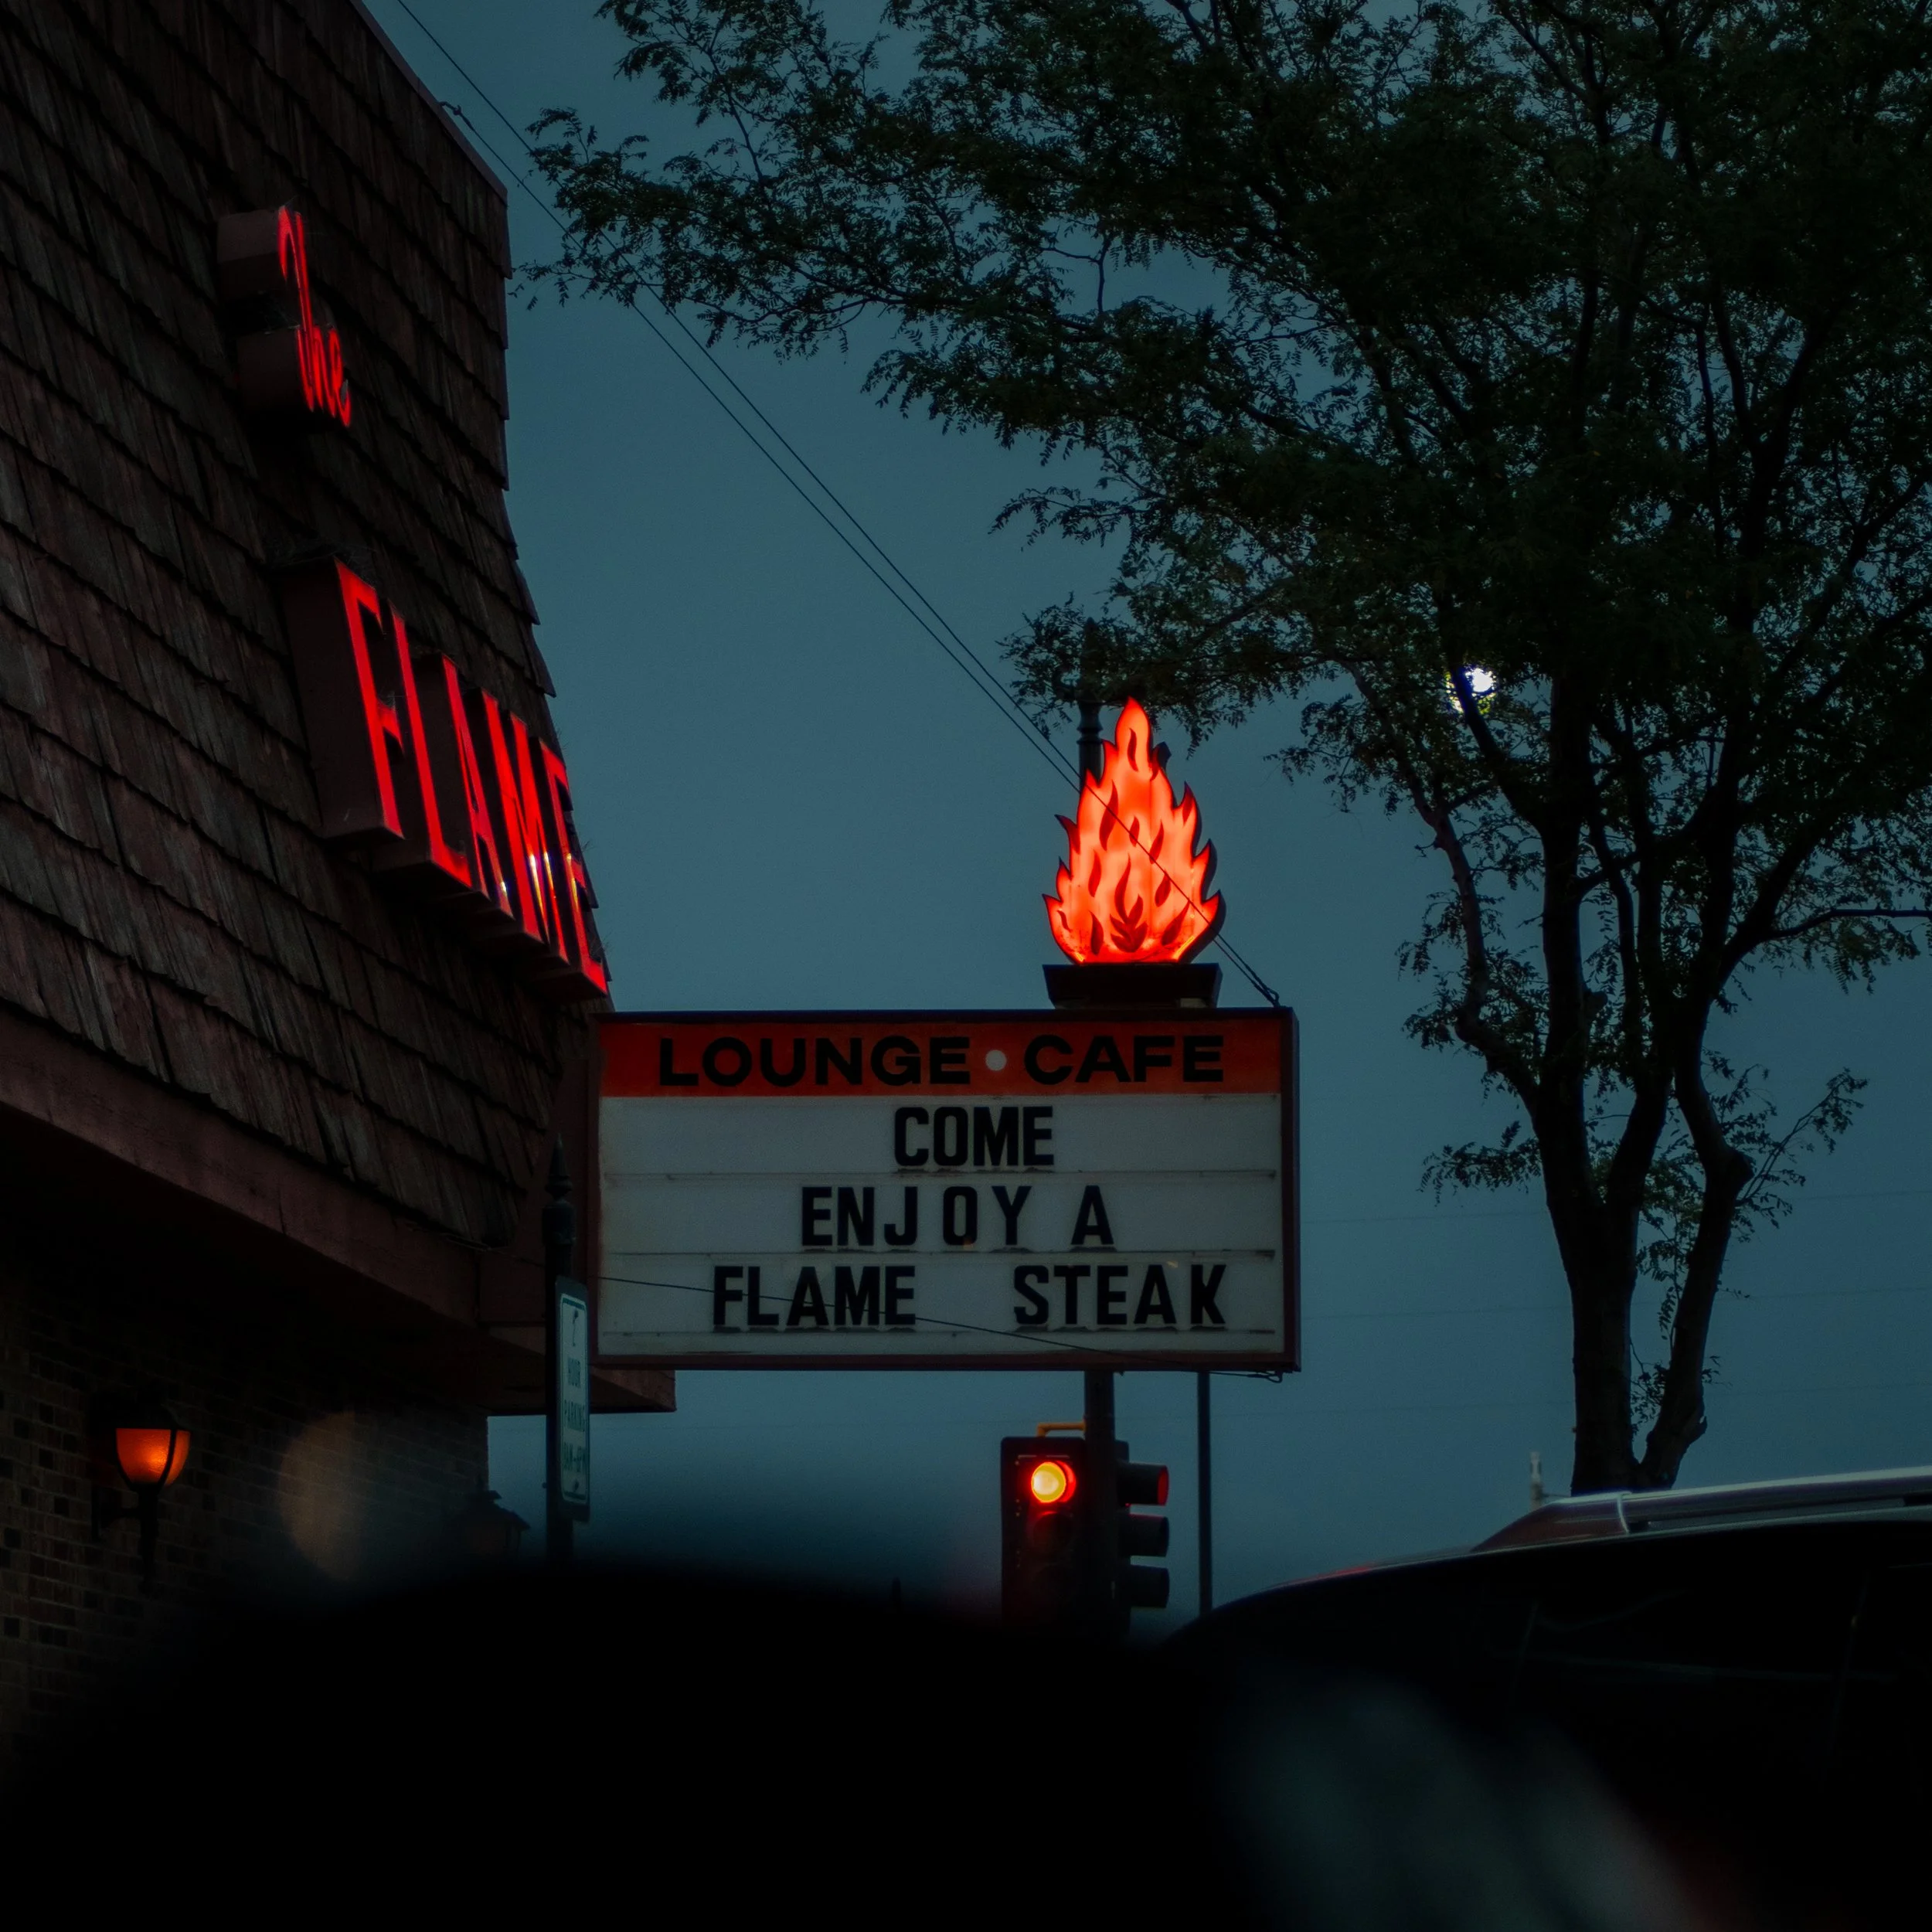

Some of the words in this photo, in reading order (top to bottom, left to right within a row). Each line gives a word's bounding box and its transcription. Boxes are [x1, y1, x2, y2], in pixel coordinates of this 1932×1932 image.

[335, 560, 607, 995] FLAME
[658, 1036, 971, 1087] LOUNGE
[1024, 1034, 1225, 1083] CAFE
[894, 1107, 1055, 1167] COME
[801, 1186, 1032, 1247] ENJOY
[1071, 1185, 1114, 1246] A
[713, 1265, 917, 1327] FLAME
[1013, 1264, 1228, 1325] STEAK
